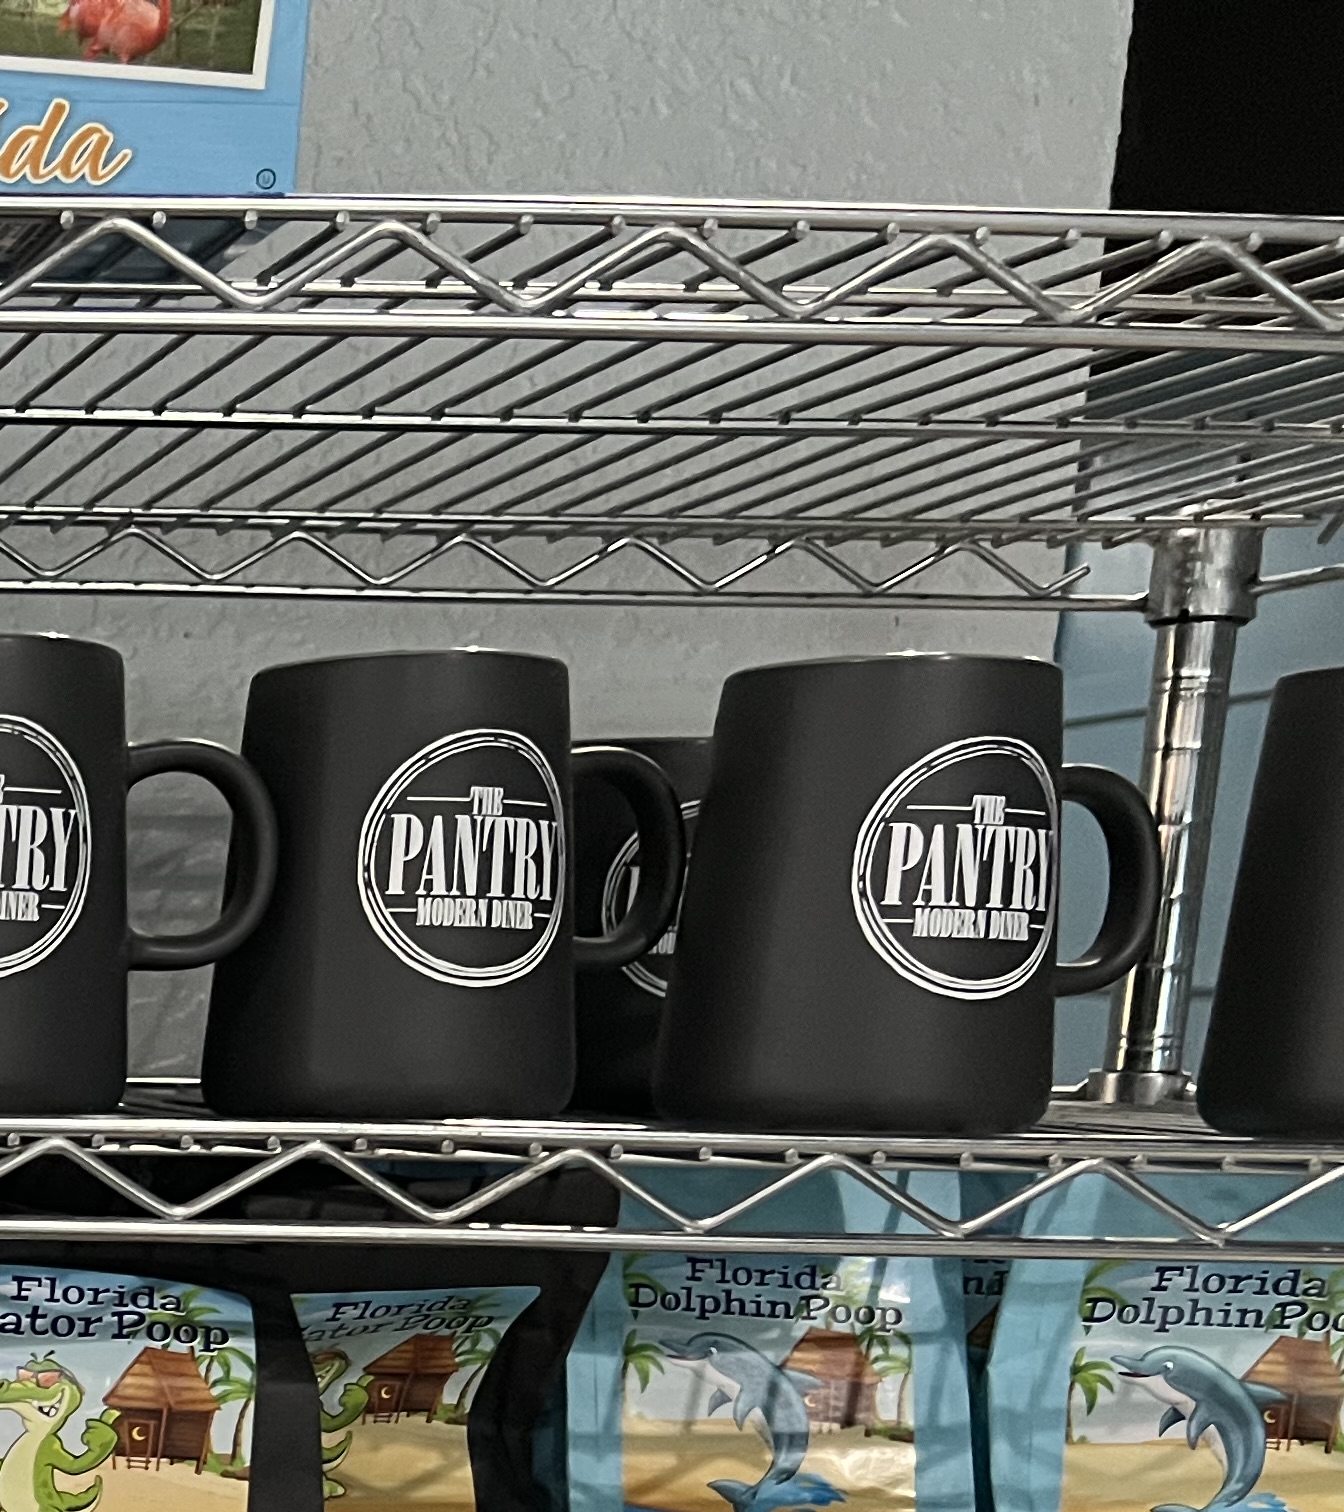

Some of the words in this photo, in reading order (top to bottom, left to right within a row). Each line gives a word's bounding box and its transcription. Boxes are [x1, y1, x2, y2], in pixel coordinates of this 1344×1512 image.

[385, 813, 559, 901] PANTRY
[880, 822, 1053, 912] PANTRY
[416, 897, 489, 928] MODERN
[490, 899, 533, 930] DINER
[9, 1273, 186, 1316] Florida
[1149, 1264, 1328, 1300] Florida
[324, 1294, 469, 1324] Florida
[393, 1312, 494, 1336] Poop
[627, 1281, 796, 1322] Dolphin
[798, 1293, 904, 1333] Poop
[1081, 1296, 1265, 1333] Dolphin
[110, 1309, 231, 1353] Poop
